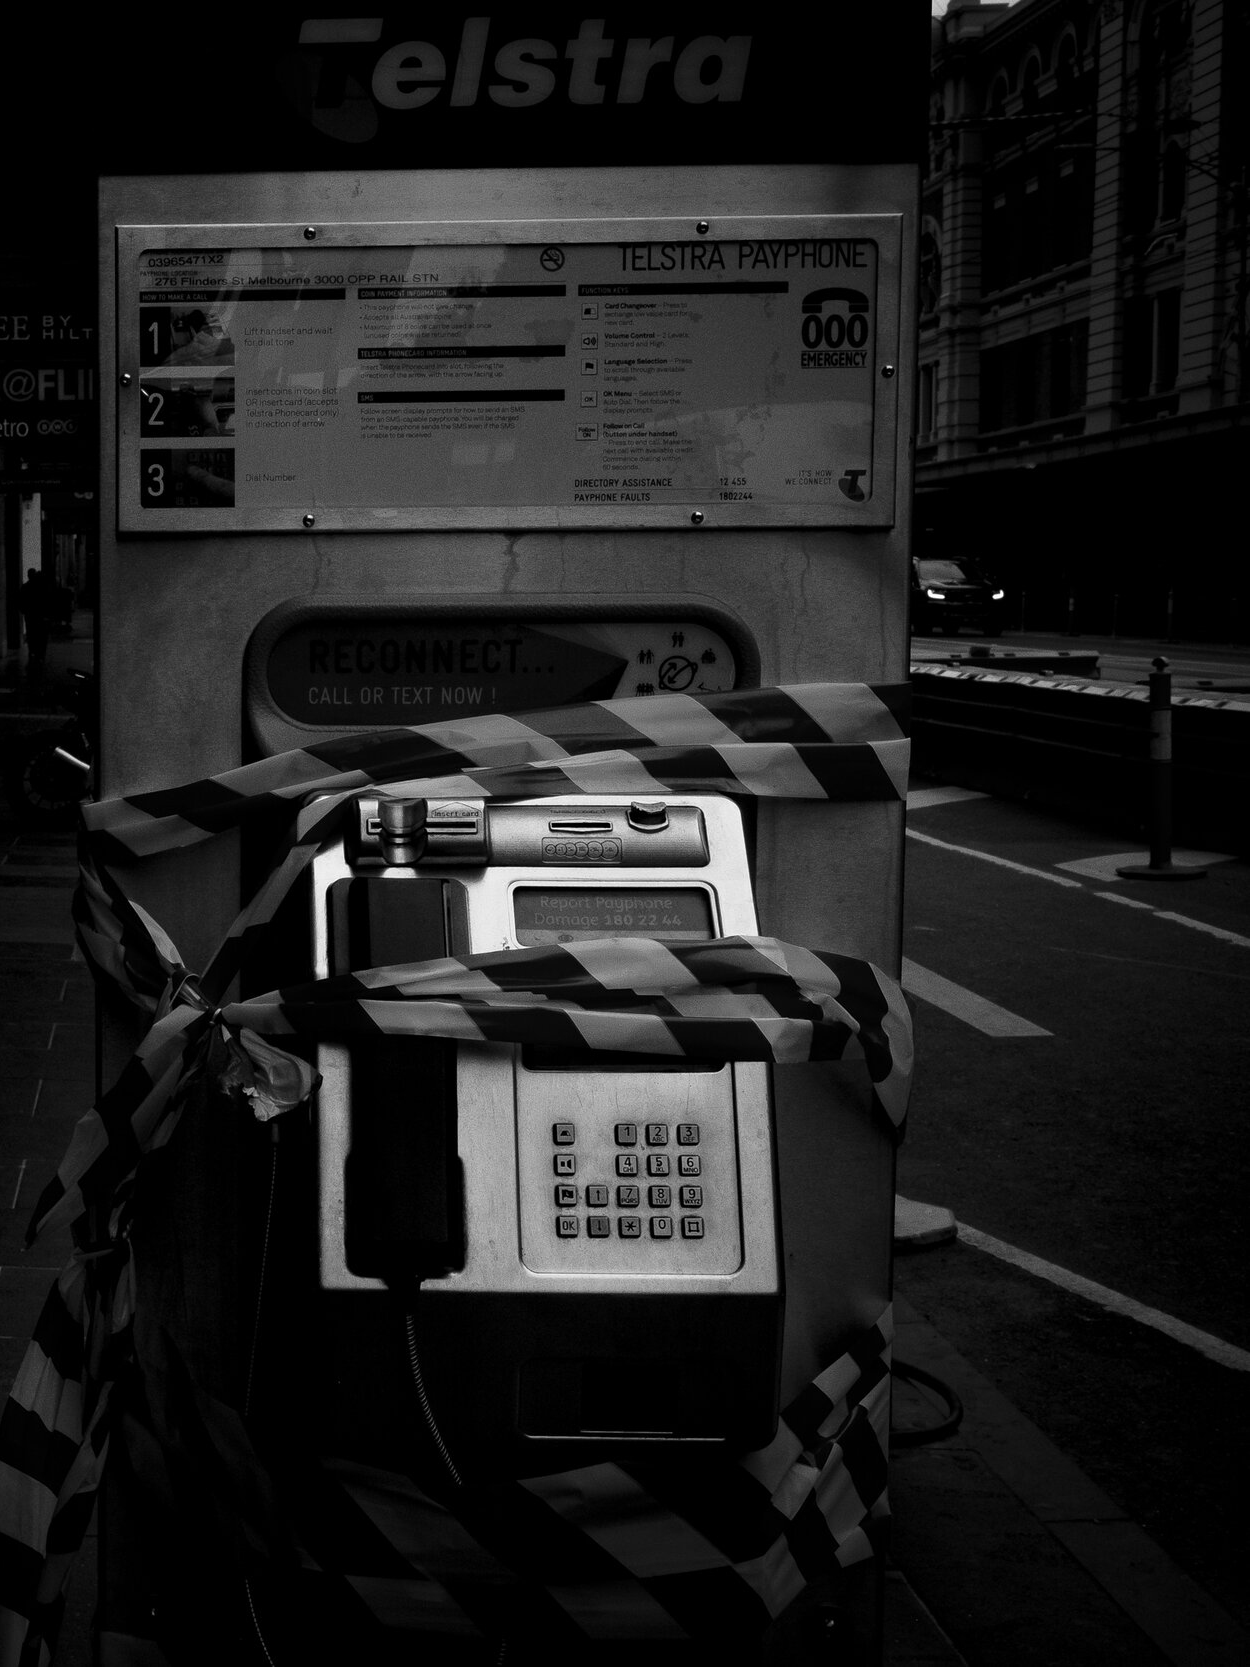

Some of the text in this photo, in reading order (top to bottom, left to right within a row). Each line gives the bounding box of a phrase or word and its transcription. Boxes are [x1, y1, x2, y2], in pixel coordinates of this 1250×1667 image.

[298, 15, 753, 108] Telstra
[148, 255, 224, 268] 03965471X2
[618, 241, 868, 271] TELSTRA PAYPHONE
[155, 273, 439, 287] 276 Flinders St Melbourne 3000 OPP RAIL STN
[42, 315, 72, 327] BY
[801, 314, 868, 349] 000
[148, 321, 159, 355] 1
[604, 357, 668, 367] Language Selection
[801, 352, 868, 367] EMERGENCY
[360, 394, 374, 402] SMS
[148, 392, 164, 425] 2
[799, 469, 832, 477] IT'S HOW
[148, 463, 164, 496] 3
[574, 477, 746, 487] DIRECTORY ASSISTANCE 12 455
[785, 477, 832, 486] WE CONNECT
[574, 492, 753, 501] PAYPHONE FAULTS 1802244
[309, 639, 554, 675] RECONNECT...
[308, 687, 352, 705] CALL
[360, 687, 384, 705] OR
[392, 687, 434, 705] TEXT
[441, 687, 484, 705] NOW
[540, 896, 672, 912] Report Payphone
[534, 913, 682, 929] Damage 180 22 44
[623, 1126, 630, 1137] 1
[654, 1126, 662, 1137] 2
[685, 1126, 693, 1137] 3
[623, 1157, 632, 1167] 4
[655, 1157, 663, 1167] 5
[686, 1157, 694, 1168] 6
[625, 1188, 633, 1198] 7
[657, 1188, 665, 1199] 8
[688, 1188, 696, 1199] 9
[562, 1220, 575, 1231] OK
